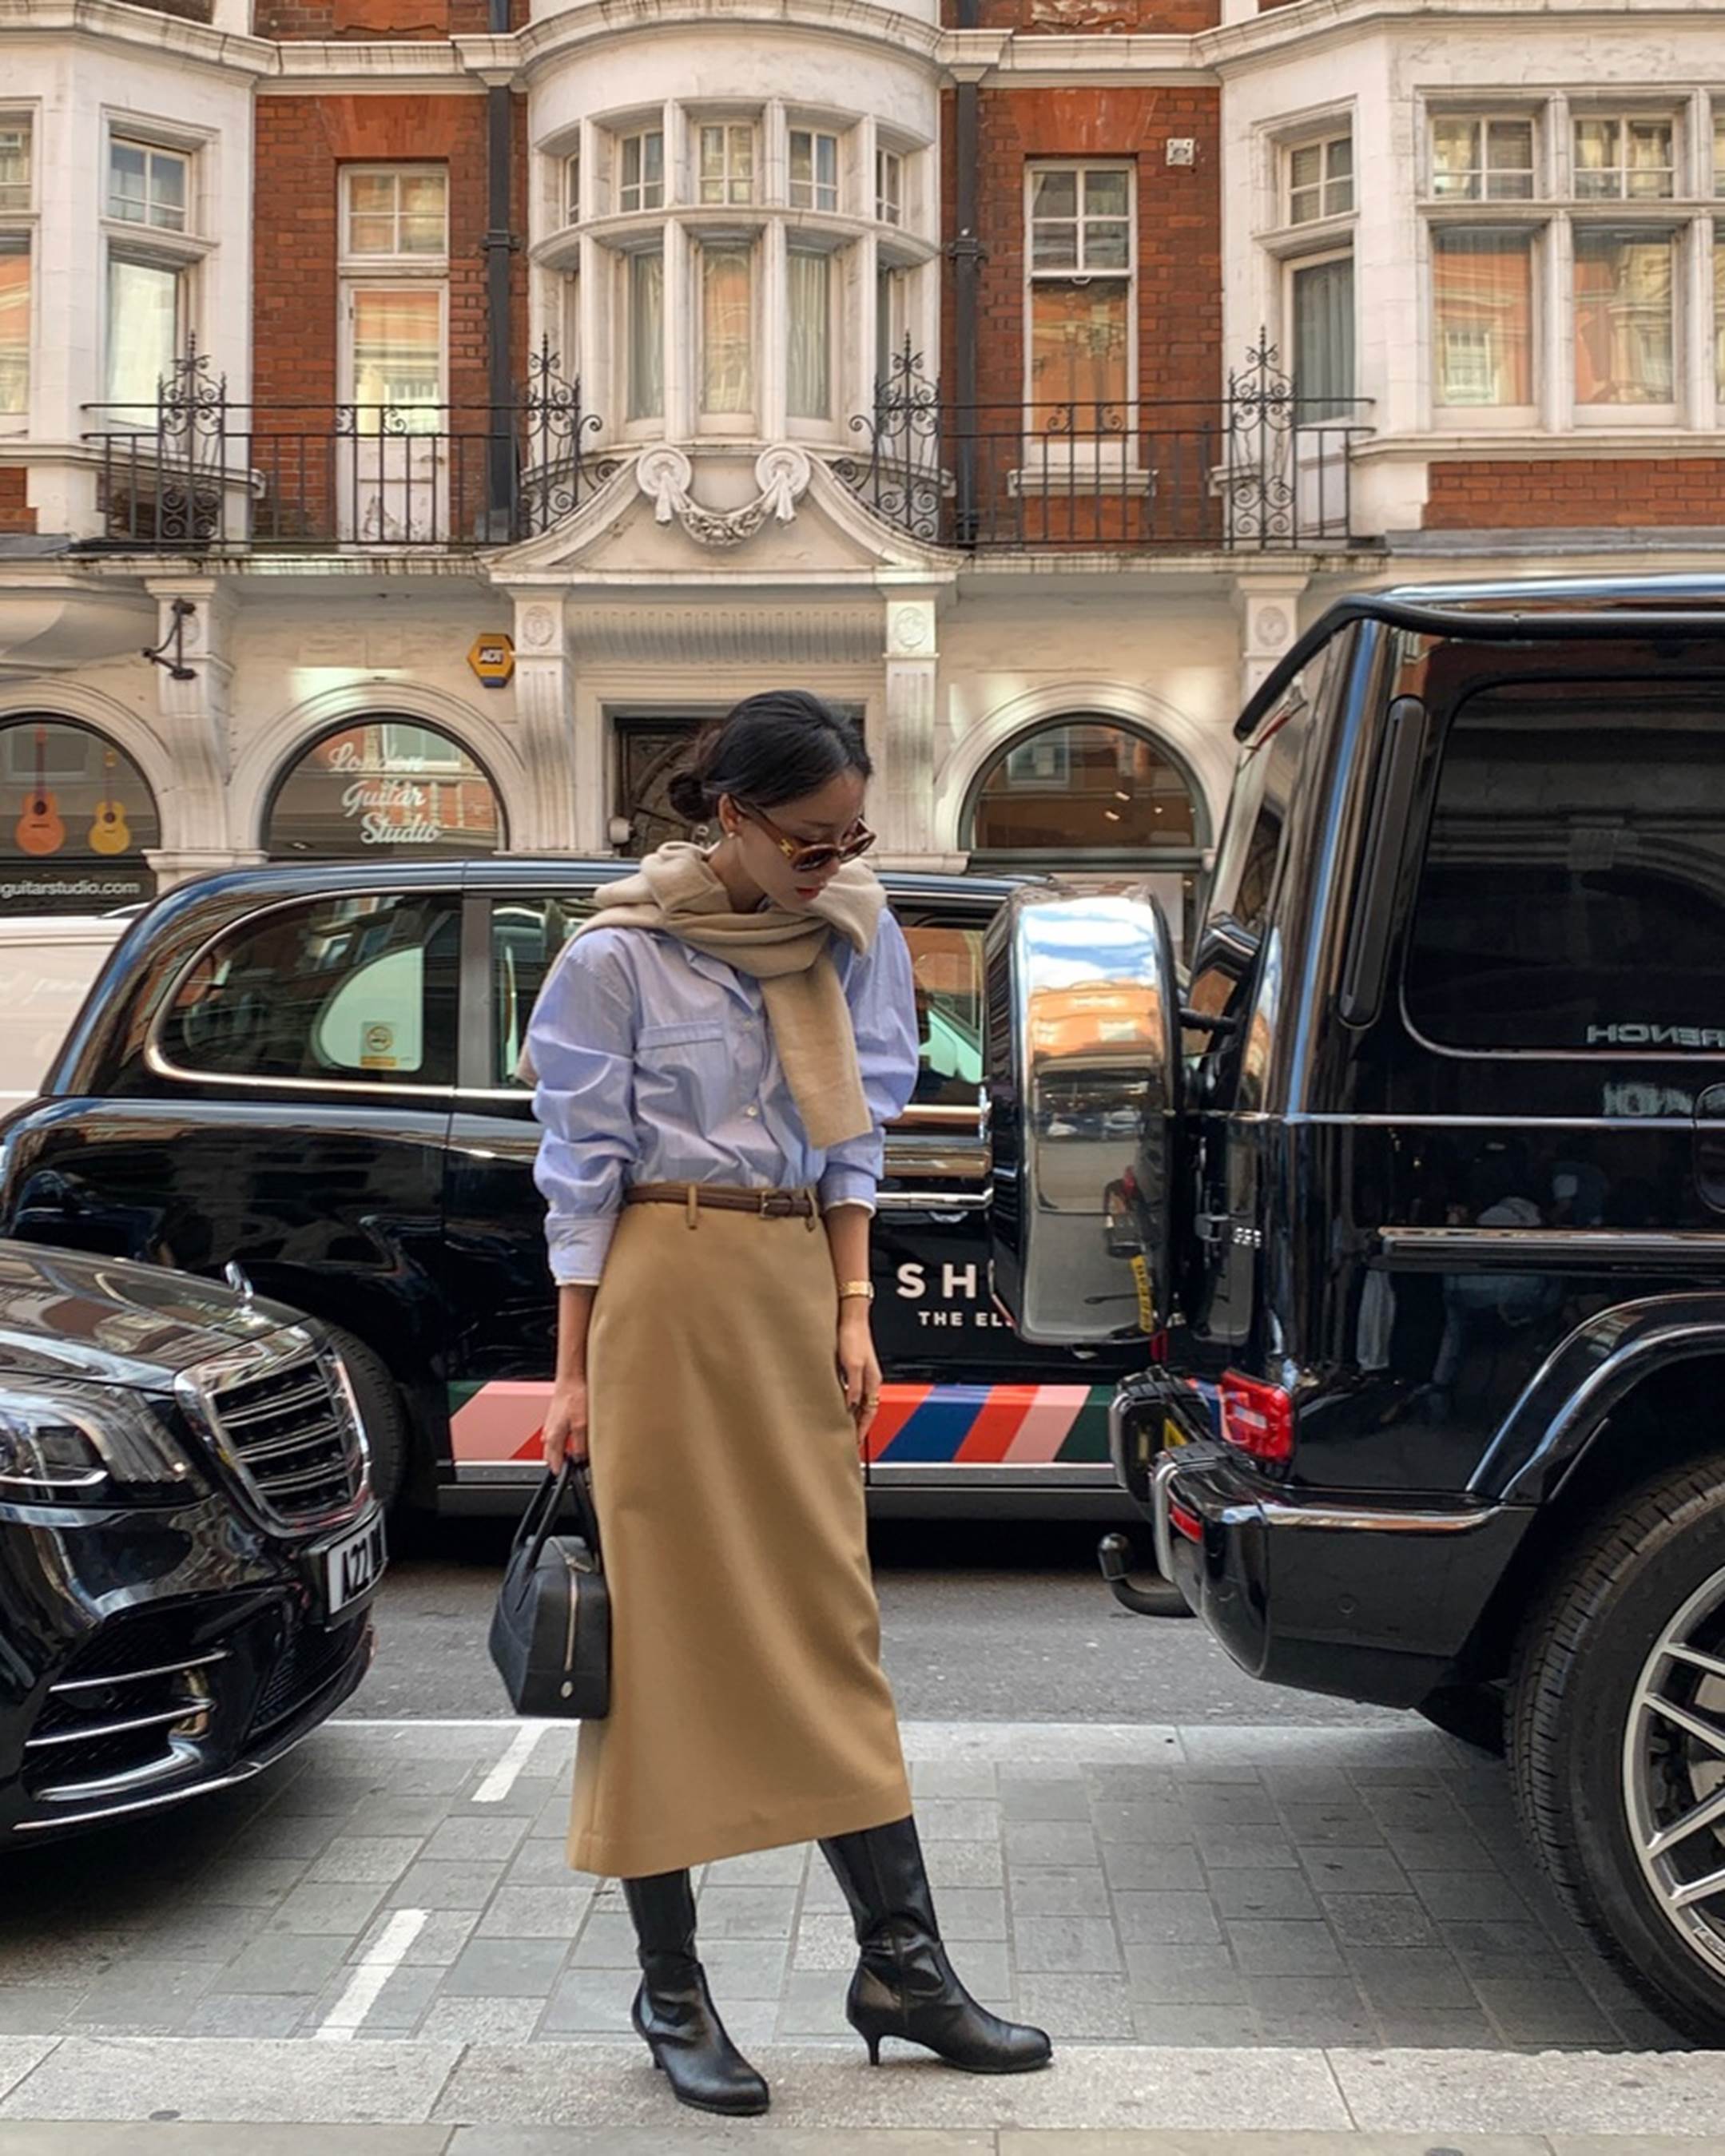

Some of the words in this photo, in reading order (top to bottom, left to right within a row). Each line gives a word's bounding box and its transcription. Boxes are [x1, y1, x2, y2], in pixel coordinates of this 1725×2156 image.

[479, 648, 503, 663] ADT
[328, 741, 424, 772] Lodon
[341, 780, 427, 817] Guitar
[360, 812, 441, 844] Studio
[0, 880, 141, 899] guitarstudio.com
[918, 1311, 964, 1327] THE
[975, 1312, 1013, 1328] EL
